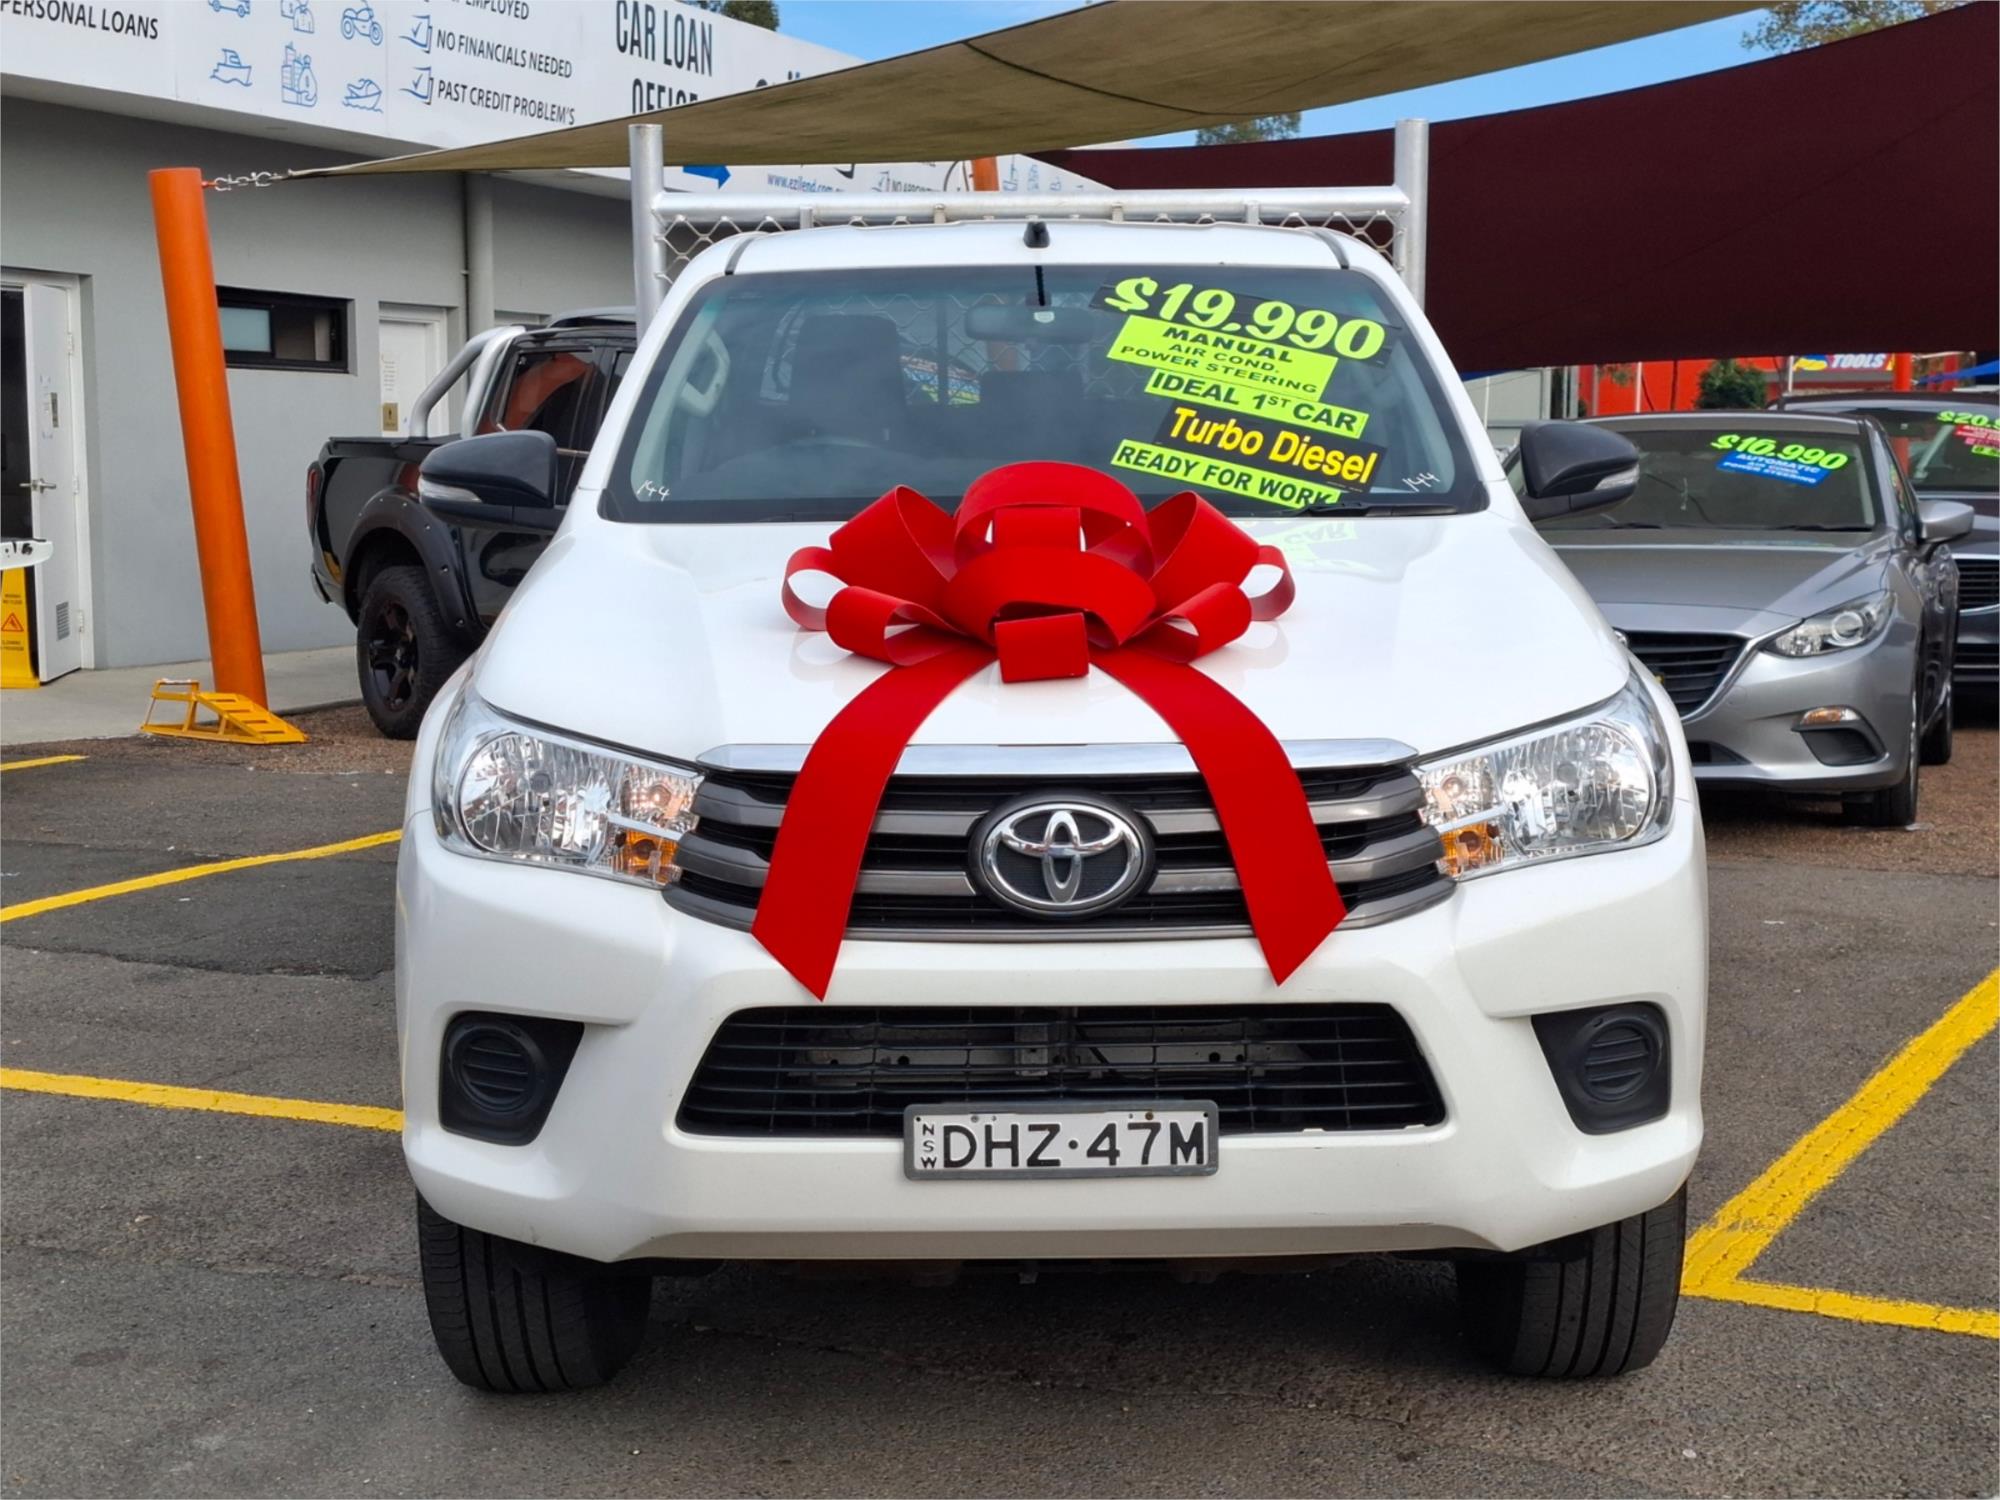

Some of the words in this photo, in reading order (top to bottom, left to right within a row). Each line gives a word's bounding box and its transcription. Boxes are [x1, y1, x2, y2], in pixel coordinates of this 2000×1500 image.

[101, 8, 158, 40] LOANS
[616, 0, 655, 61] CAR
[664, 10, 712, 77] LOAN
[437, 29, 455, 50] NO
[458, 35, 526, 68] FINANCIALS
[529, 52, 572, 78] NEEDED
[438, 80, 467, 103] PAST
[470, 87, 512, 112] CREDIT
[513, 97, 575, 125] PROBLEM'S
[768, 174, 845, 193] www.ezilendcom
[1104, 277, 1385, 359] $19.990
[1163, 327, 1293, 363] MANUAL
[1169, 343, 1206, 357] AIR
[1215, 353, 1280, 373] COND.
[1831, 353, 1887, 368] TOOLS
[1121, 345, 1199, 369] POWER
[1206, 363, 1317, 393] STEERING
[1152, 372, 1239, 405] IDEAL
[1293, 402, 1358, 432] CAR
[1170, 407, 1263, 455] Turbo
[1269, 430, 1378, 484] Diesel
[1710, 434, 1848, 469] $16.990
[1736, 453, 1821, 474] AUTOMATIC
[1117, 446, 1200, 477] READY
[1202, 465, 1251, 490] FOR
[1259, 478, 1333, 504] WORK
[921, 1124, 938, 1169] NSW
